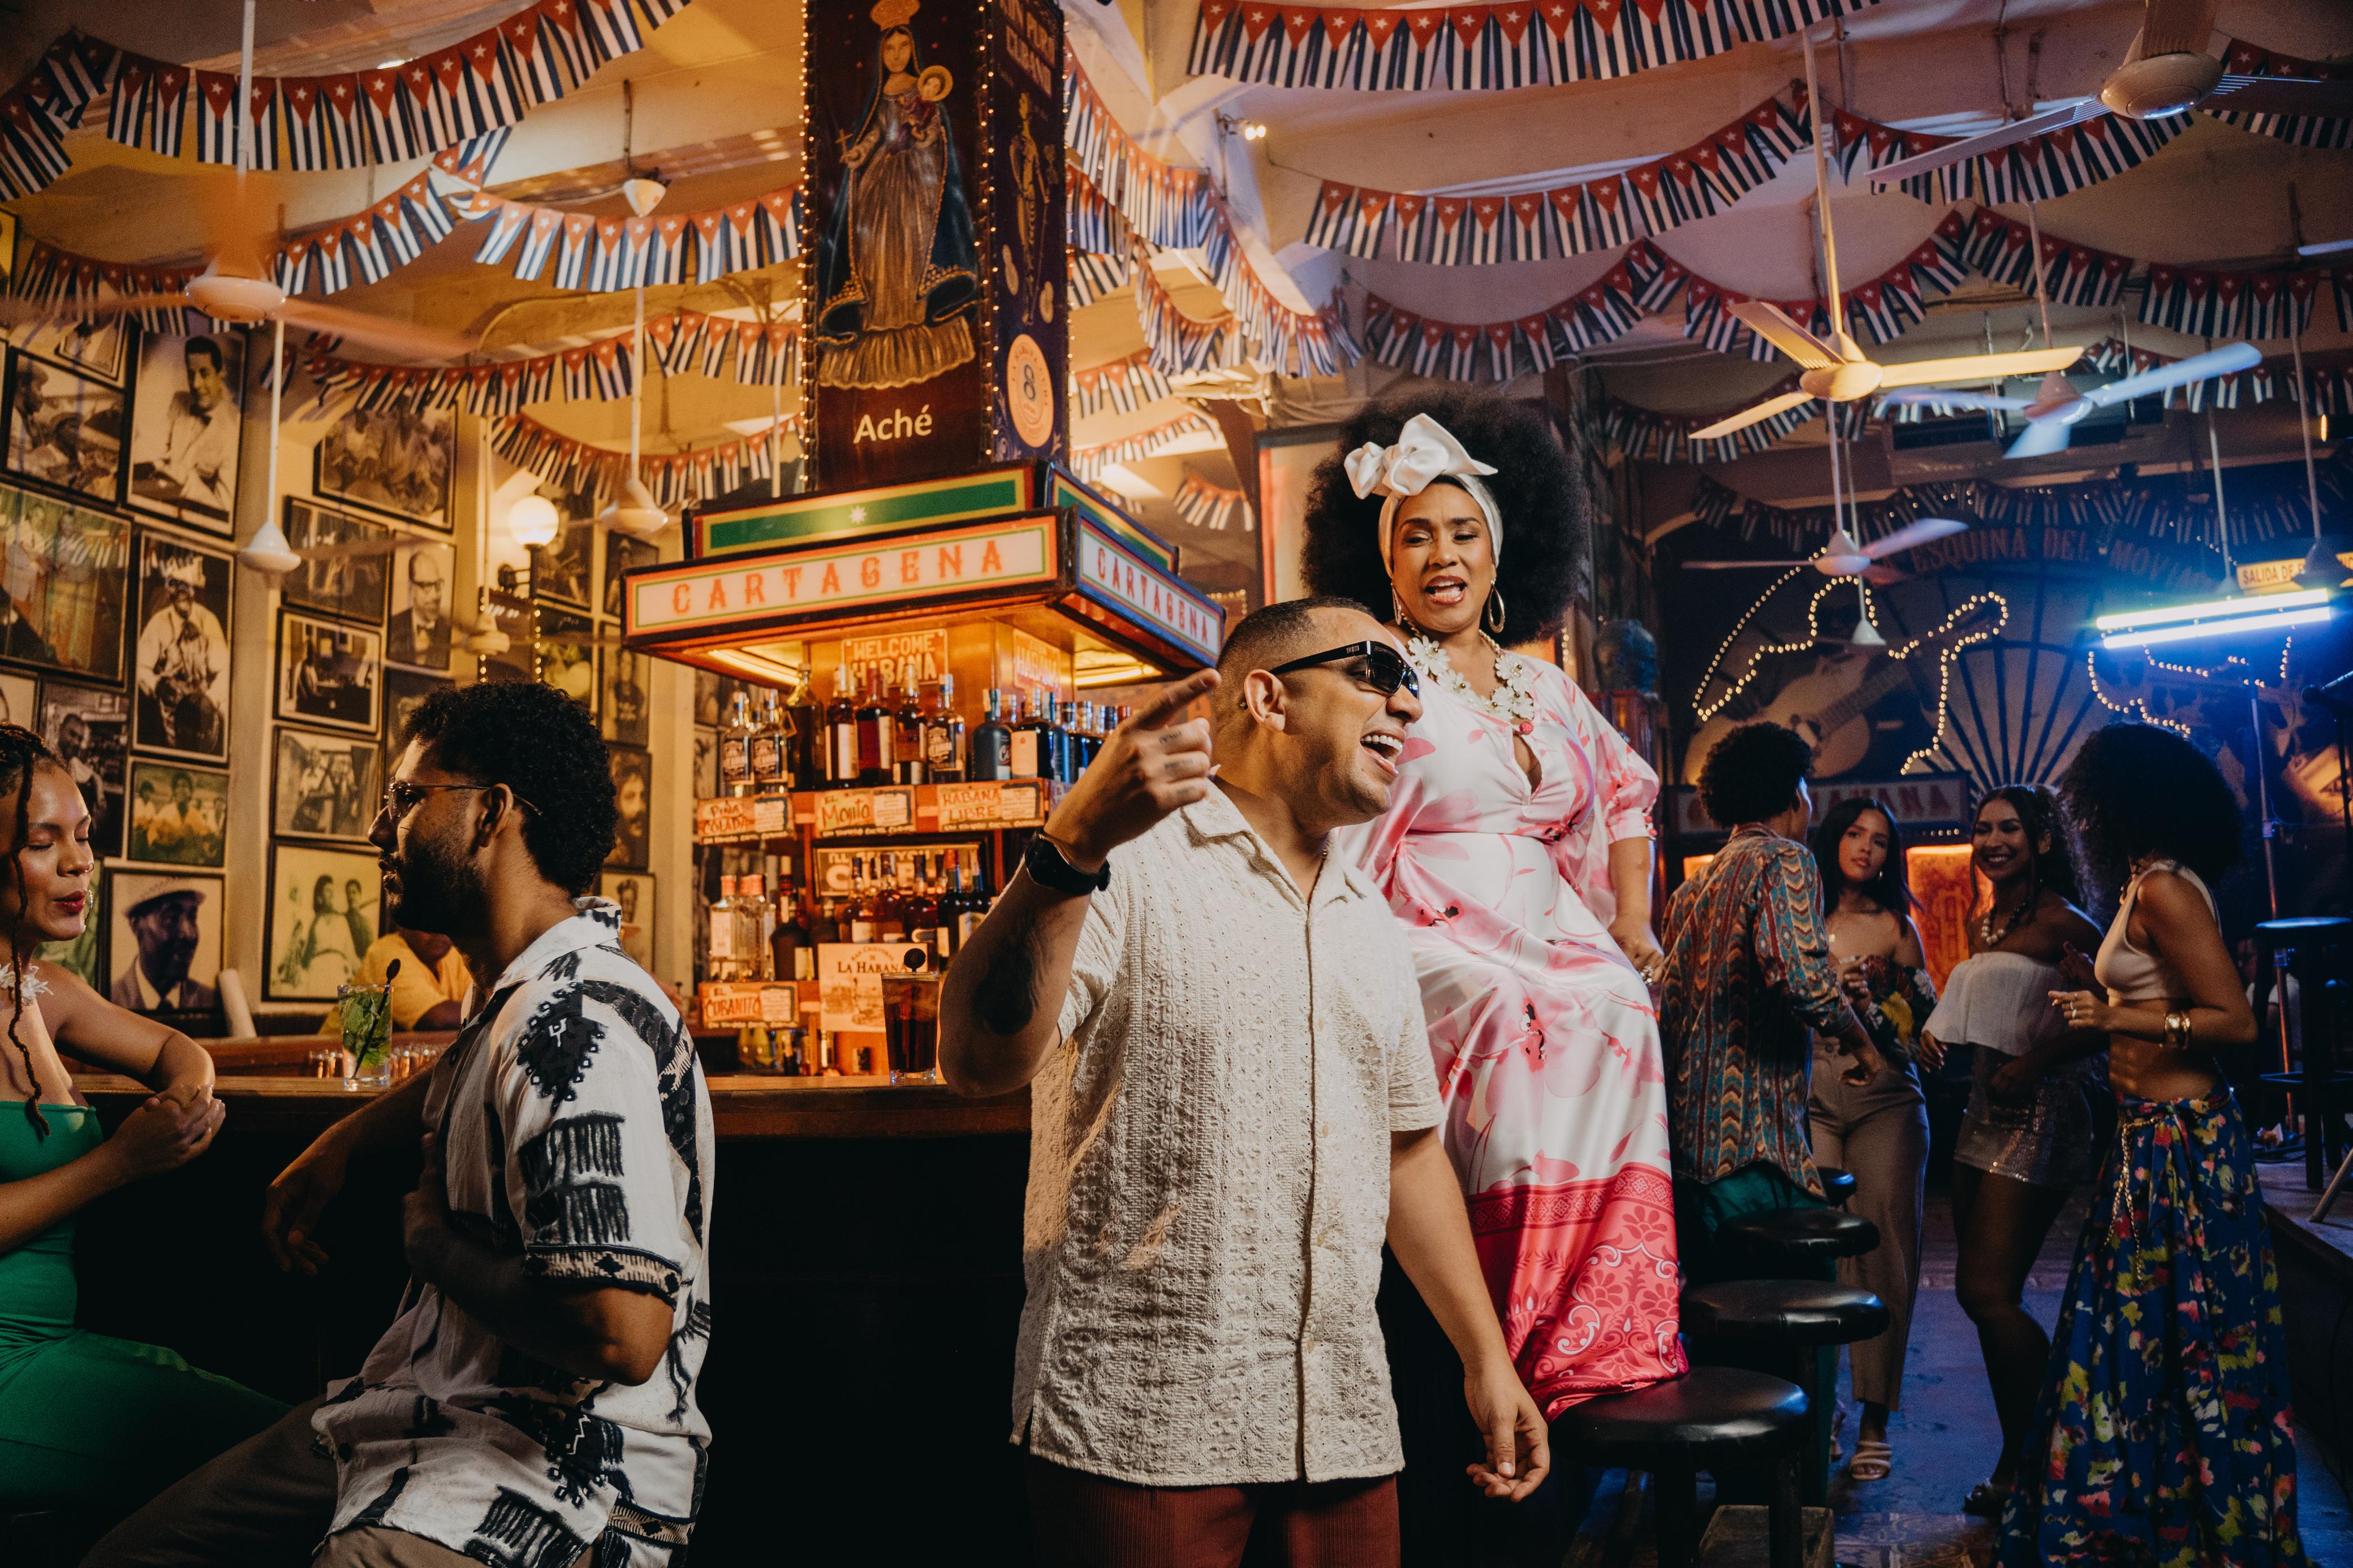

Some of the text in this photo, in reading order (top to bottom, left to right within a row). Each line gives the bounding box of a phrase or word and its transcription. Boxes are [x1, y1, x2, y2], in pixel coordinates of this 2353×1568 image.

[853, 404, 933, 444] Aché
[673, 540, 1003, 614] CARTAGENA
[2243, 567, 2279, 585] SALIDA
[1097, 546, 1208, 646] CARTAGENA
[852, 633, 936, 661] WELCOME
[943, 788, 1002, 806] HABANA
[949, 806, 996, 823] LIBRE
